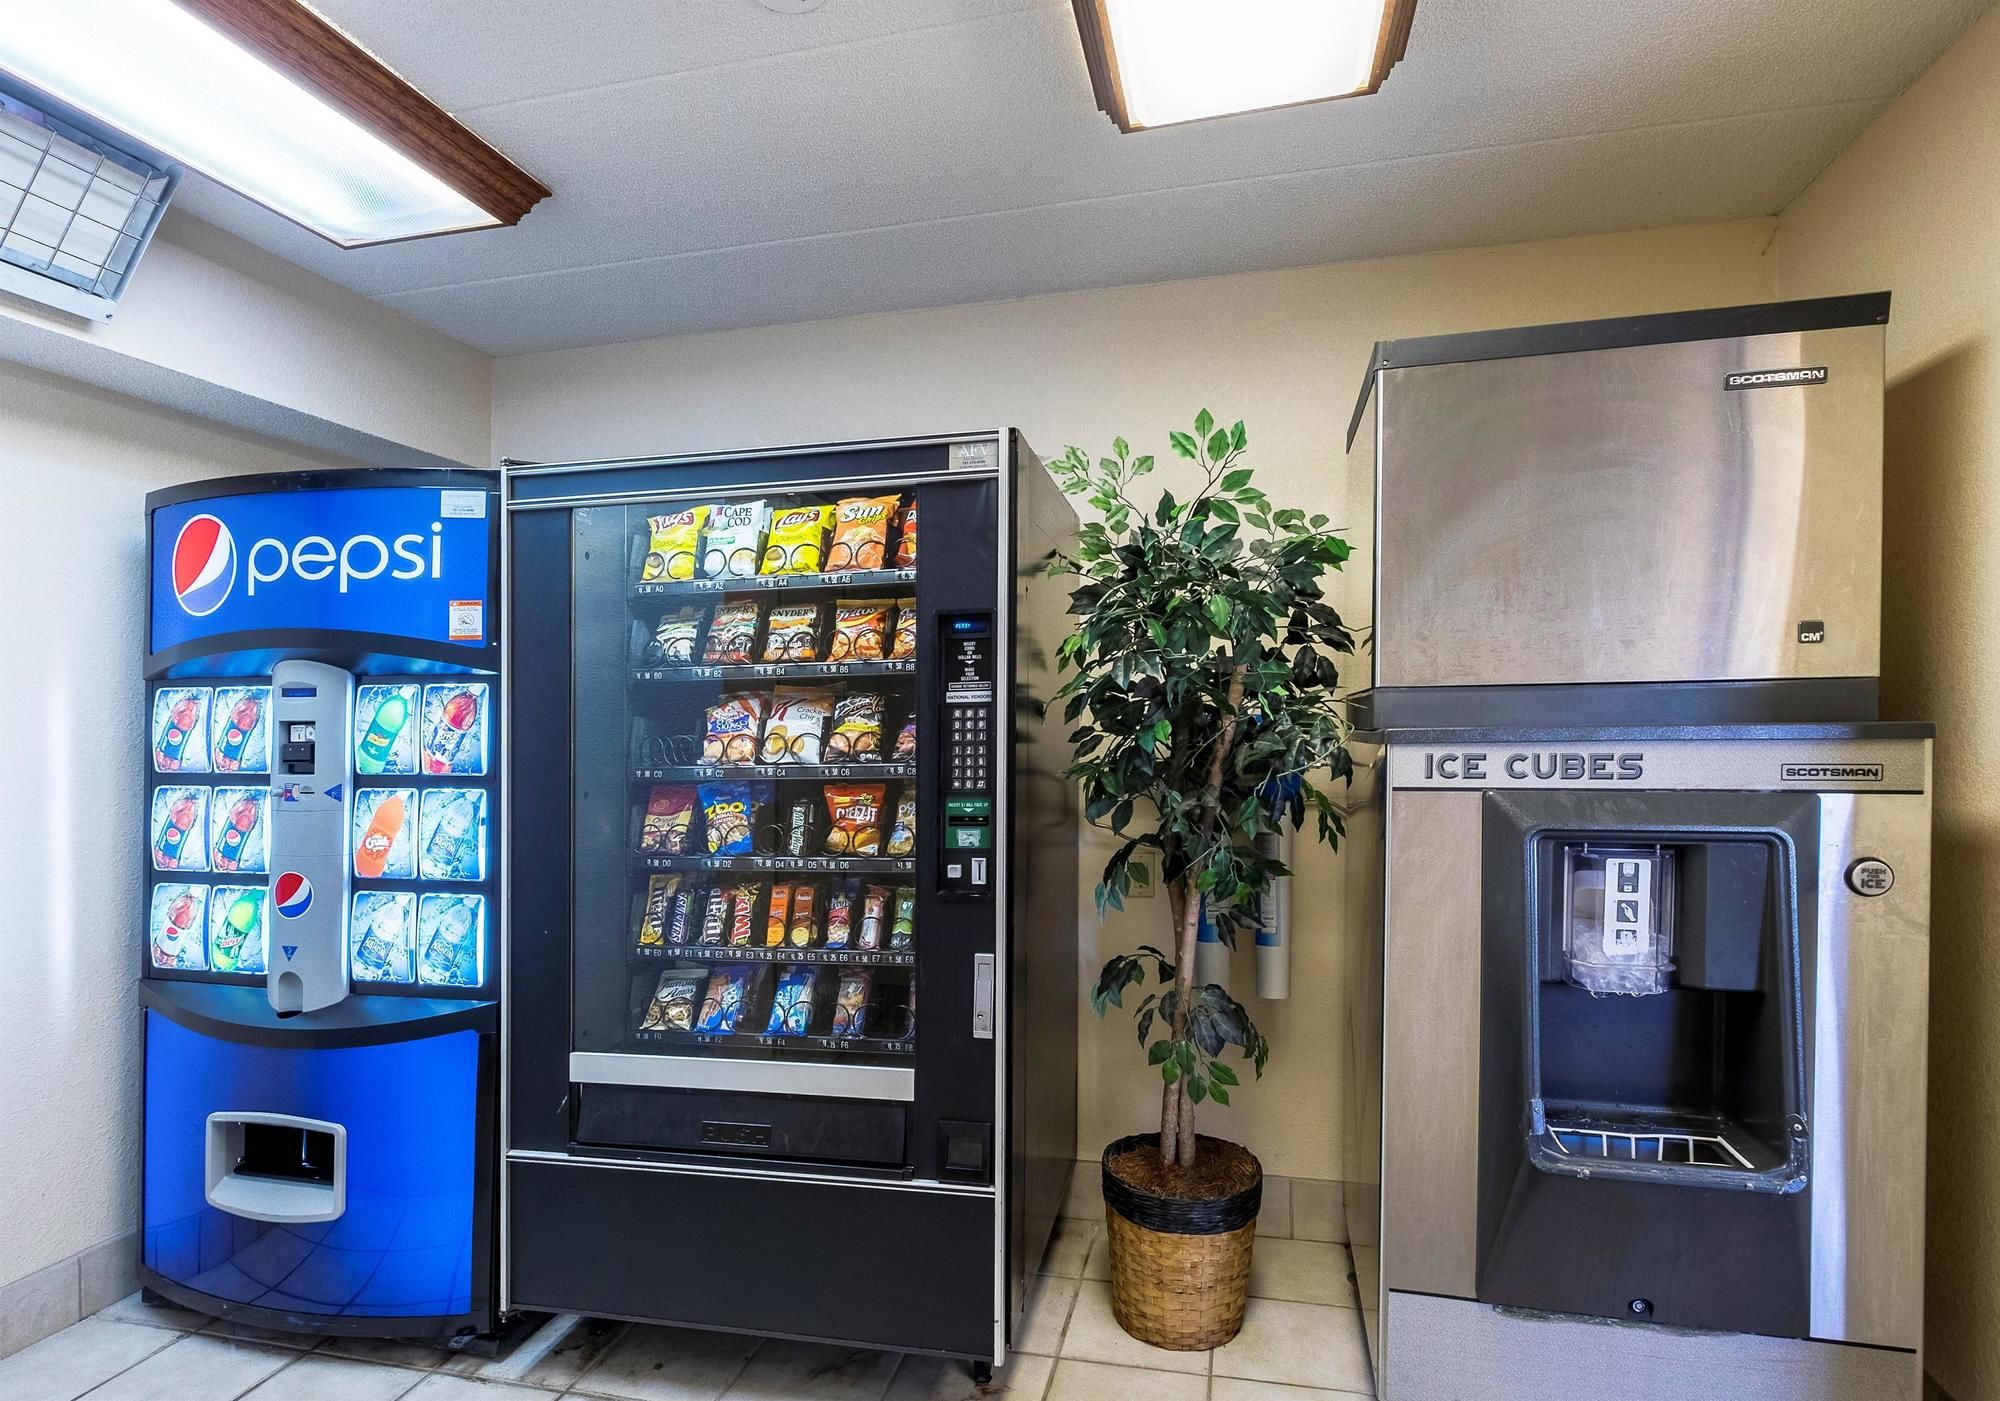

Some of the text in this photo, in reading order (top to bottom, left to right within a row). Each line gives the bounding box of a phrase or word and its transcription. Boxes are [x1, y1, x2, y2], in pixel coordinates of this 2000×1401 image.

[1730, 370, 1824, 385] SCOTSMAN
[724, 506, 752, 517] CAPE
[842, 504, 886, 522] Sun
[727, 516, 752, 528] COD
[248, 521, 443, 596] pepsi
[778, 578, 788, 587] A4
[841, 575, 851, 584] A6
[655, 584, 664, 593] A0
[715, 581, 724, 590] A2
[776, 667, 785, 676] B4
[839, 665, 849, 673] B6
[906, 663, 915, 671] B8
[713, 670, 722, 678] B2
[954, 746, 985, 754] 1 2 3
[1424, 752, 1644, 780] ICE CUBES
[715, 770, 724, 778] C2
[776, 768, 786, 777] C4
[840, 768, 850, 776] C6
[1786, 768, 1879, 777] SCOTSMAN
[704, 801, 744, 818] ZOO
[1861, 879, 1886, 889] ICE
[653, 949, 662, 957] E0
[715, 950, 724, 958] E2
[745, 951, 754, 959] E3
[777, 952, 785, 960] E4
[807, 952, 816, 961] E5
[839, 953, 848, 962] E6
[871, 954, 880, 962] E7
[905, 954, 914, 963] E8
